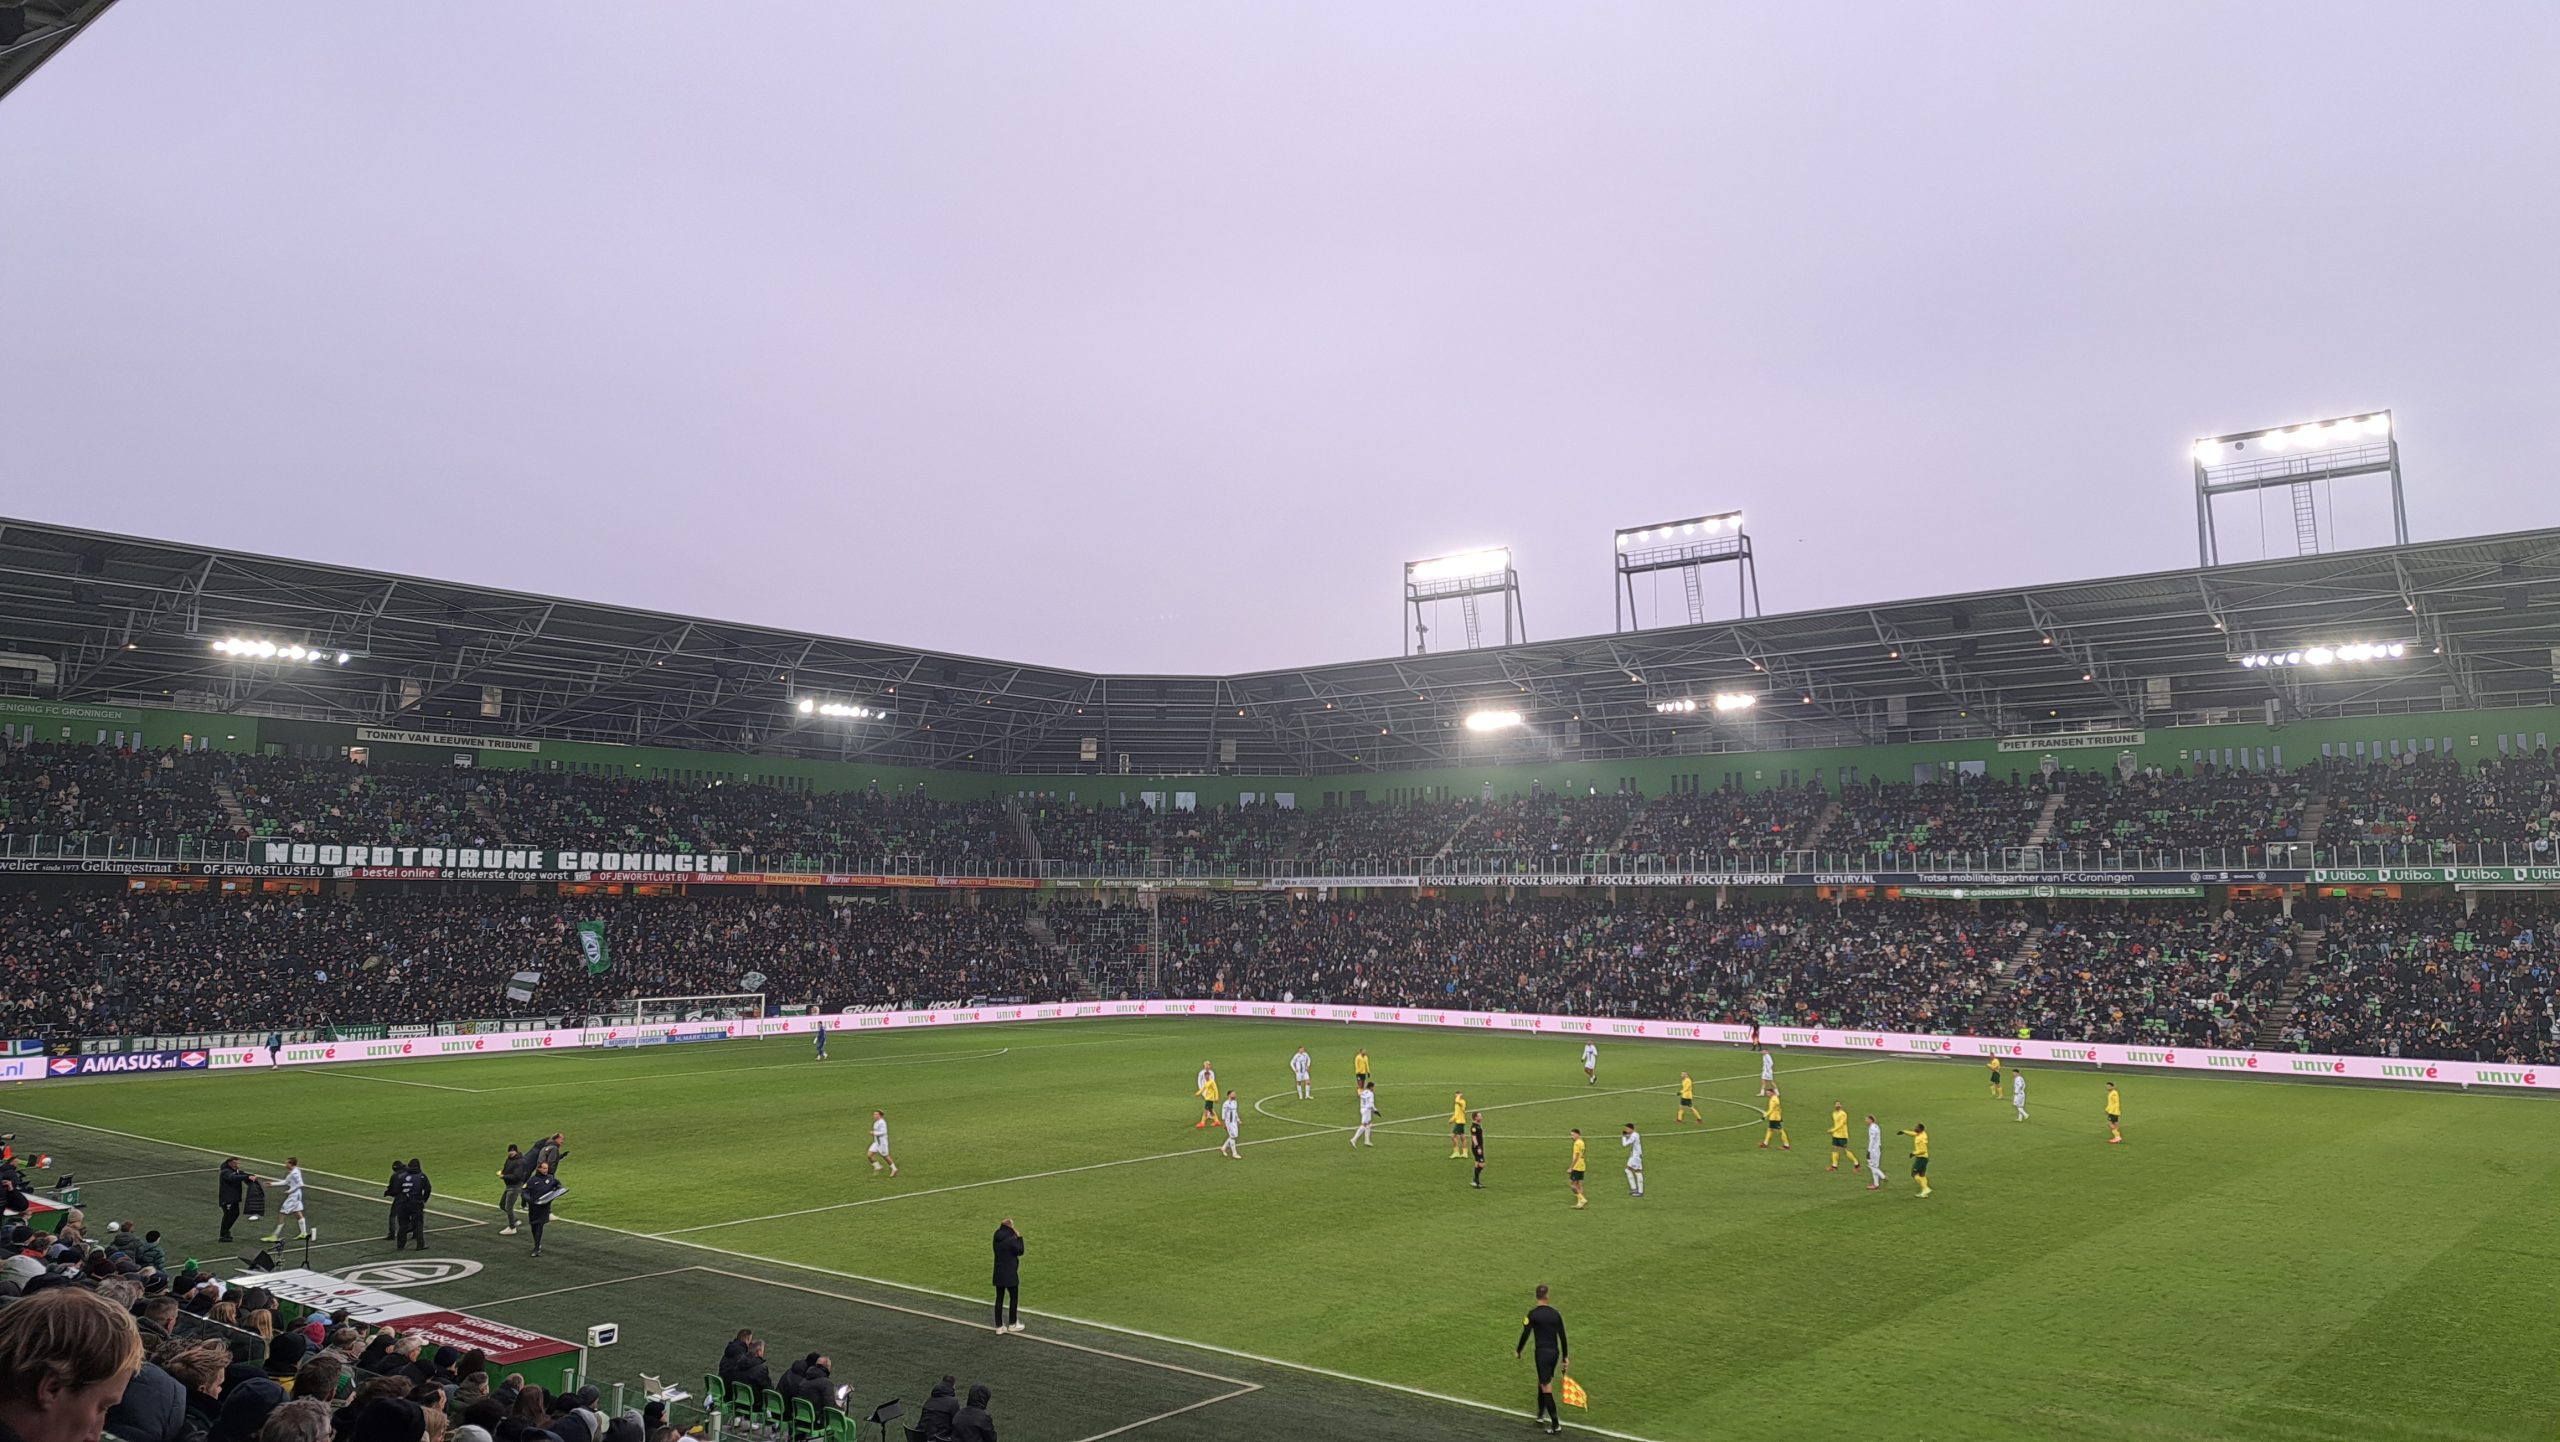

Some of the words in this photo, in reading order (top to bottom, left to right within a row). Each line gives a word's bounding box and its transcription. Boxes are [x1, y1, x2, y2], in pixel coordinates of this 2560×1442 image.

[0, 703, 43, 714] ENIGING
[45, 706, 60, 715] FC
[61, 708, 122, 719] GRONINGEN
[365, 730, 405, 741] TONNY
[408, 733, 430, 743] VAN
[433, 735, 485, 747] LEEUWEN
[487, 739, 533, 750] TRIBUNE
[2003, 740, 2030, 750] PIET
[2031, 738, 2084, 748] FRANSEN
[2087, 734, 2138, 745] TRIBUNE
[265, 843, 543, 869] NOORDTRIBUNE
[557, 851, 729, 873] GRONINGEN
[81, 860, 172, 875] Gelkingestraat
[175, 863, 191, 873] 34
[203, 865, 325, 877] OFJEWORSTLUST.EU
[362, 867, 398, 878] bestel
[400, 868, 436, 878] online
[441, 869, 454, 878] de
[457, 869, 505, 879] lekkerste
[508, 869, 537, 881] droge
[539, 872, 568, 880] worst
[600, 872, 689, 882] OFJEWORSTLUST.EU
[697, 873, 725, 883] Marne
[826, 874, 850, 884] Marne
[851, 876, 882, 884] MOSTERD
[1813, 875, 1876, 884] CENTURY.NL
[1917, 874, 1948, 883] Trotse
[1950, 873, 2040, 884] mobiliteitspartner
[2042, 874, 2060, 882] van
[2062, 873, 2077, 882] FC
[2078, 873, 2135, 884] Groningen
[2330, 870, 2370, 881] Utibo.
[2394, 870, 2435, 880] Utibo.
[2461, 869, 2504, 880] Utibo.
[936, 877, 959, 886] Marne
[959, 878, 986, 886] MOSTERD
[1340, 878, 1388, 886] ELEKTROMOTOREN
[1426, 877, 1457, 886] FOCUZ
[1457, 877, 1499, 886] SUPPORT
[1507, 877, 1540, 886] FOCUZ
[1540, 877, 1586, 886] SUPPORT
[1598, 876, 1633, 885] FOCUZ
[1634, 876, 1683, 885] SUPPORT
[1692, 876, 1731, 885] FOCUZ
[1732, 876, 1786, 885] SUPPORT
[1970, 888, 2029, 898] GRONINGEN
[2060, 887, 2130, 896] SUPPORTERS
[2132, 887, 2148, 895] ON
[2148, 887, 2196, 895] WHEELS
[841, 1001, 899, 1015] GRUNN
[1037, 1006, 1062, 1017] univé
[1077, 1005, 1101, 1014] univé
[1116, 1003, 1145, 1012] univé
[1165, 1001, 1196, 1012] univé
[1214, 1002, 1237, 1013] univé
[1252, 1004, 1276, 1015] univé
[1291, 1005, 1316, 1016] univé
[907, 1011, 936, 1024] univé
[953, 1009, 980, 1021] univé
[996, 1007, 1022, 1019] univé
[1332, 1008, 1358, 1019] univé
[1374, 1010, 1400, 1021] univé
[1417, 1012, 1445, 1023] univé
[756, 1019, 790, 1033] univé
[810, 1017, 841, 1030] uivé
[859, 1014, 890, 1026] univé
[1463, 1015, 1492, 1026] univé
[1510, 1017, 1541, 1028] univé
[1561, 1019, 1592, 1031] univé
[388, 1023, 429, 1032] MARTINI
[436, 1023, 456, 1037] TEN
[475, 1020, 500, 1033] BOER
[1612, 1022, 1645, 1034] univé
[1666, 1024, 1700, 1037] univé
[511, 1033, 552, 1048] univé
[1723, 1031, 1750, 1040] univ
[1782, 1029, 1820, 1044] univé
[1844, 1034, 1884, 1048] univé
[366, 1039, 412, 1056] univé
[442, 1036, 485, 1051] univé
[1910, 1038, 1952, 1052] univé
[1978, 1042, 2022, 1056] univé
[287, 1044, 336, 1060] univé
[2051, 1046, 2097, 1061] univé
[2126, 1049, 2176, 1064] univé
[82, 1053, 177, 1073] AMASUS.nl
[2207, 1053, 2258, 1069] univé
[2291, 1058, 2346, 1074] univé
[2381, 1063, 2438, 1079] univé
[2476, 1069, 2537, 1085] univé
